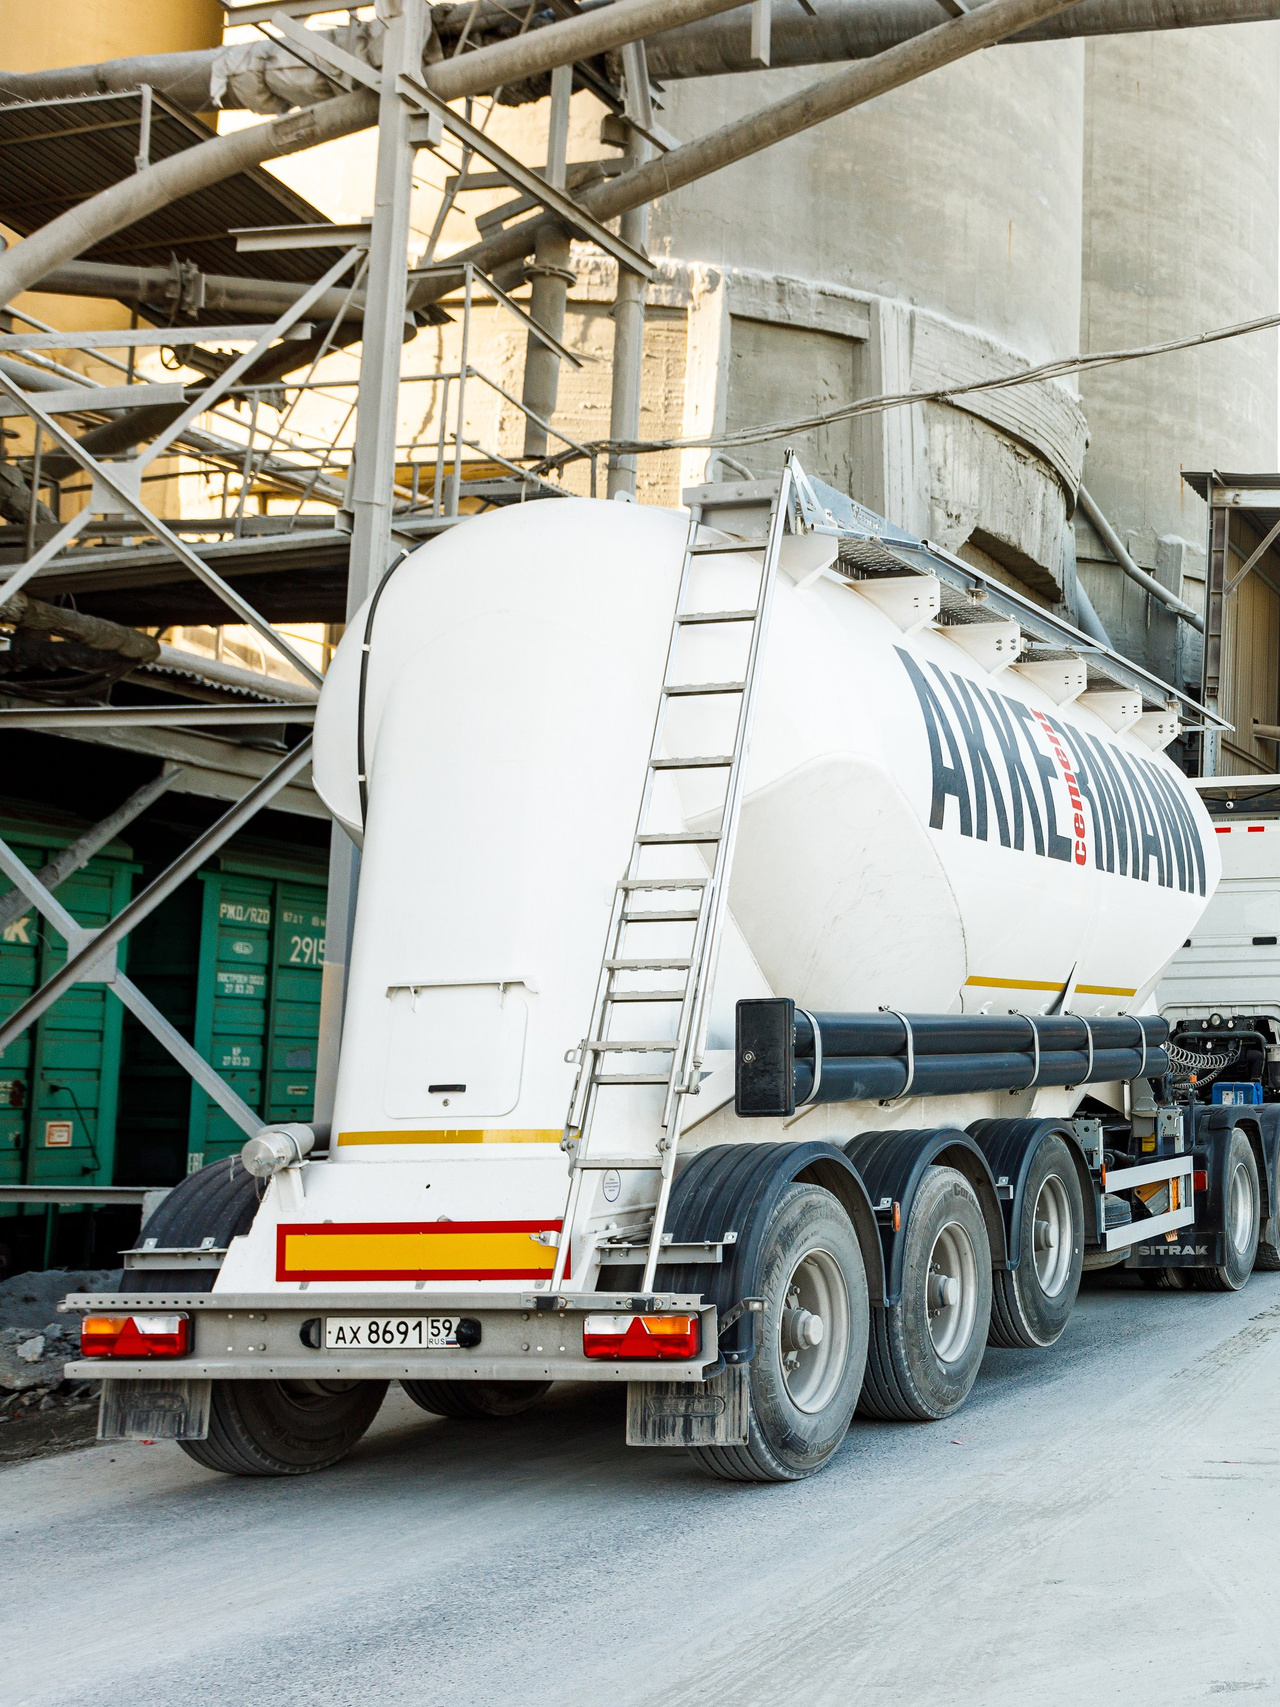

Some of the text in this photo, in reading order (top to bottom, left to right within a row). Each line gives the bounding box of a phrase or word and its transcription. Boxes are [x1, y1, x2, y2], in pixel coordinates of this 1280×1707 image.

[892, 644, 1206, 898] AKKERMANN
[1138, 1245, 1209, 1256] SITRAK
[367, 1320, 423, 1345] 8691
[430, 1318, 453, 1338] 59
